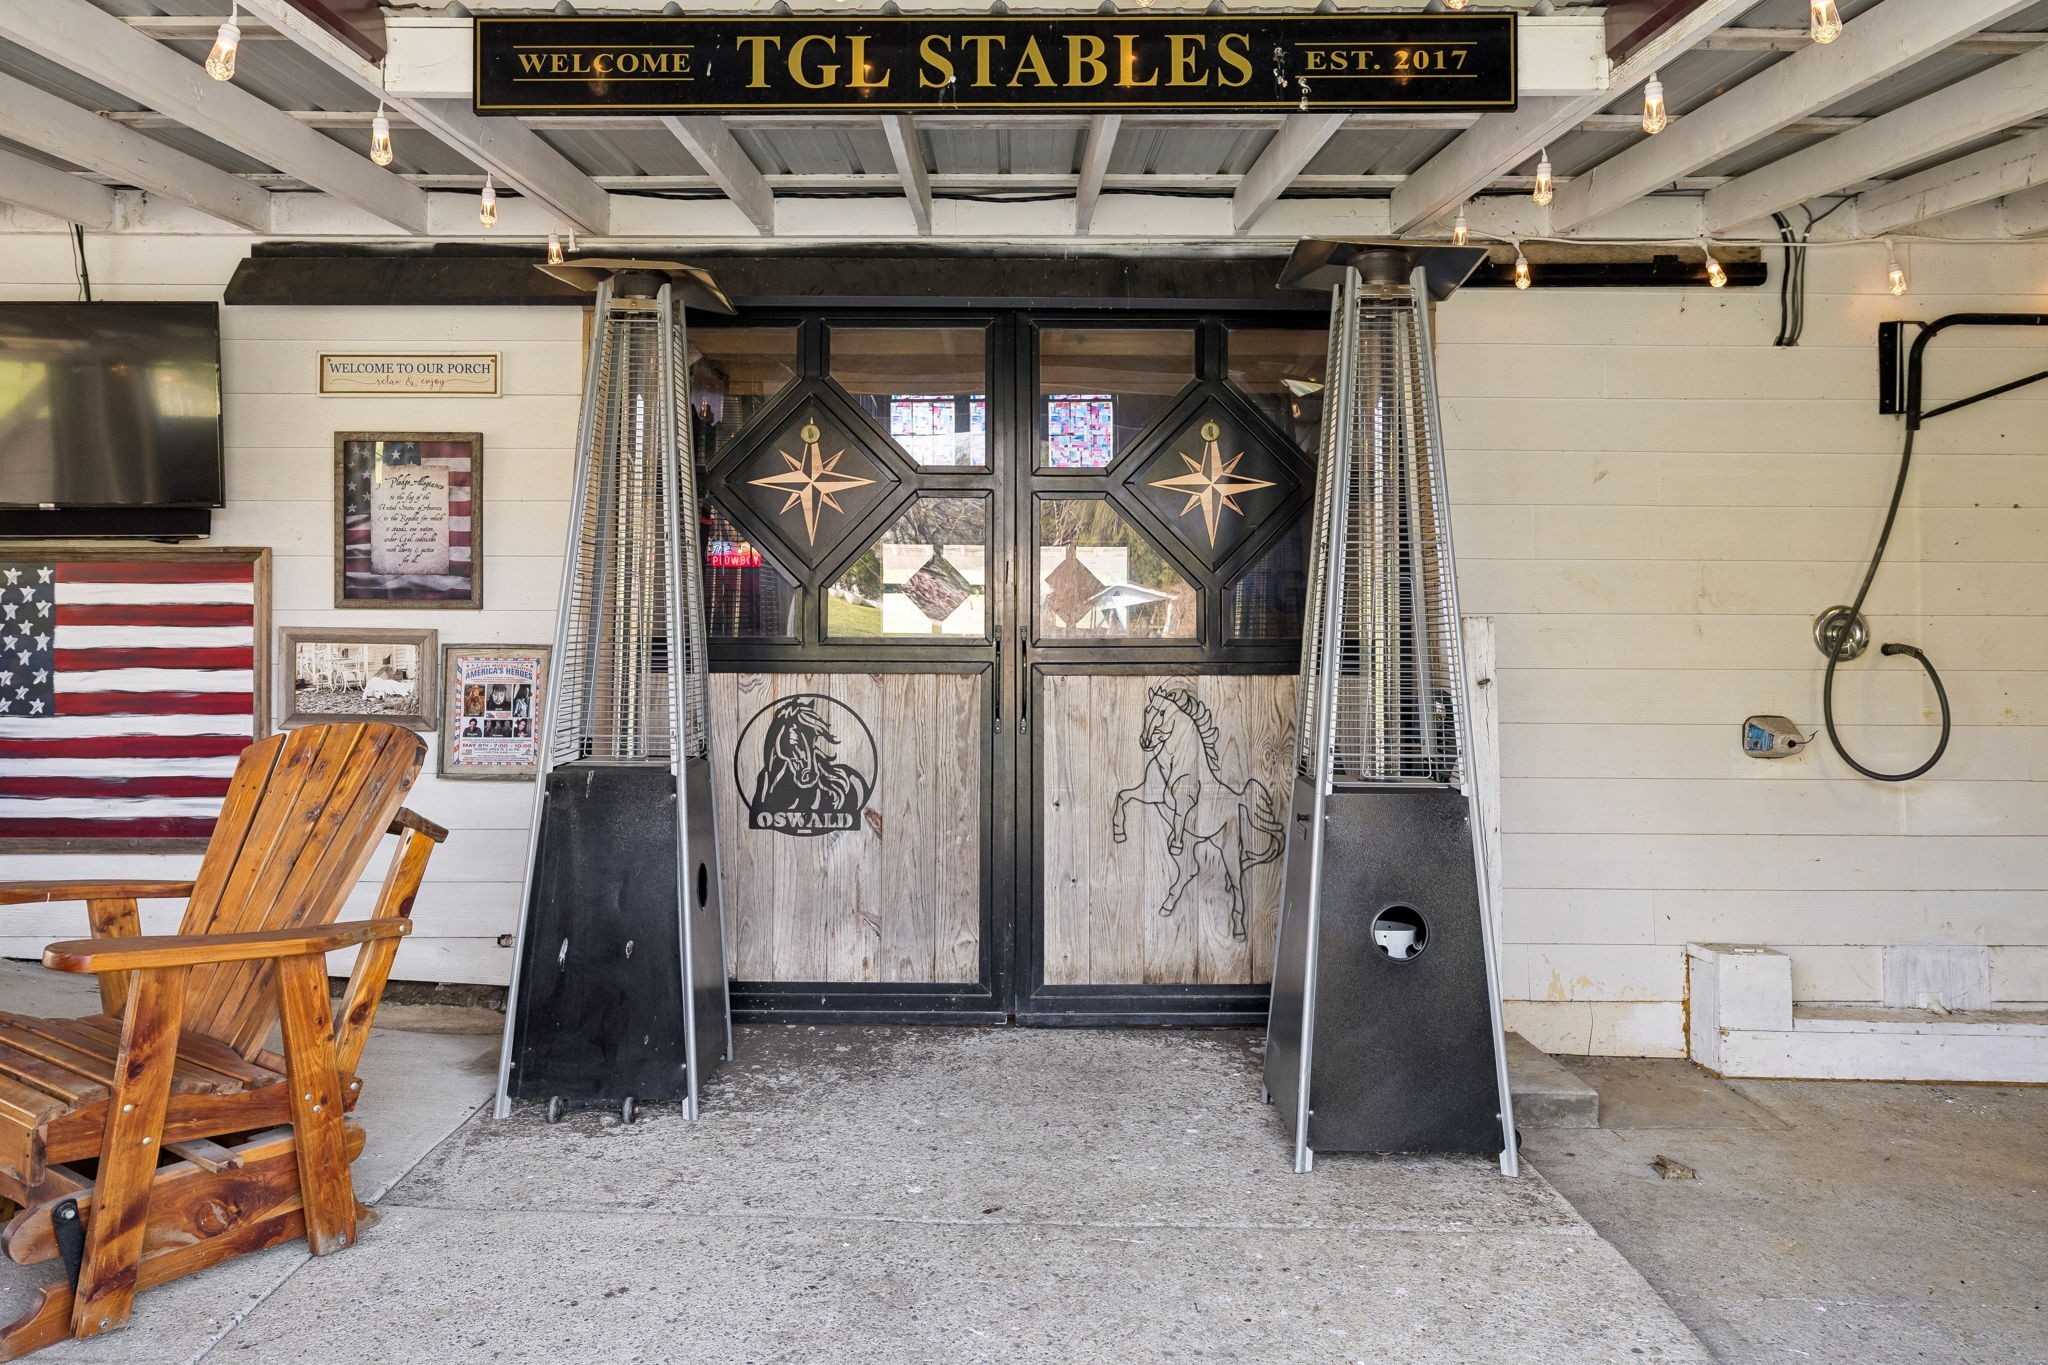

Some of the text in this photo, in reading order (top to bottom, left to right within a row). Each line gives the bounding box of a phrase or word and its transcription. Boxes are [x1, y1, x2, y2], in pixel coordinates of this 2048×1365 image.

[518, 33, 1468, 89] WELCOME TGL STABLES EST. 2017
[330, 363, 490, 374] WELCOME TO OUR PORCH
[376, 376, 446, 390] relax & enjoy
[385, 474, 444, 490] Pledge Allegiance
[396, 492, 406, 500] the
[423, 492, 432, 500] the
[378, 502, 400, 510] United
[399, 502, 416, 510] States
[390, 513, 399, 521] the
[430, 513, 446, 521] which
[466, 668, 504, 680] AMERICA'S
[506, 668, 532, 680] HEROES
[756, 812, 853, 828] OSWALD
